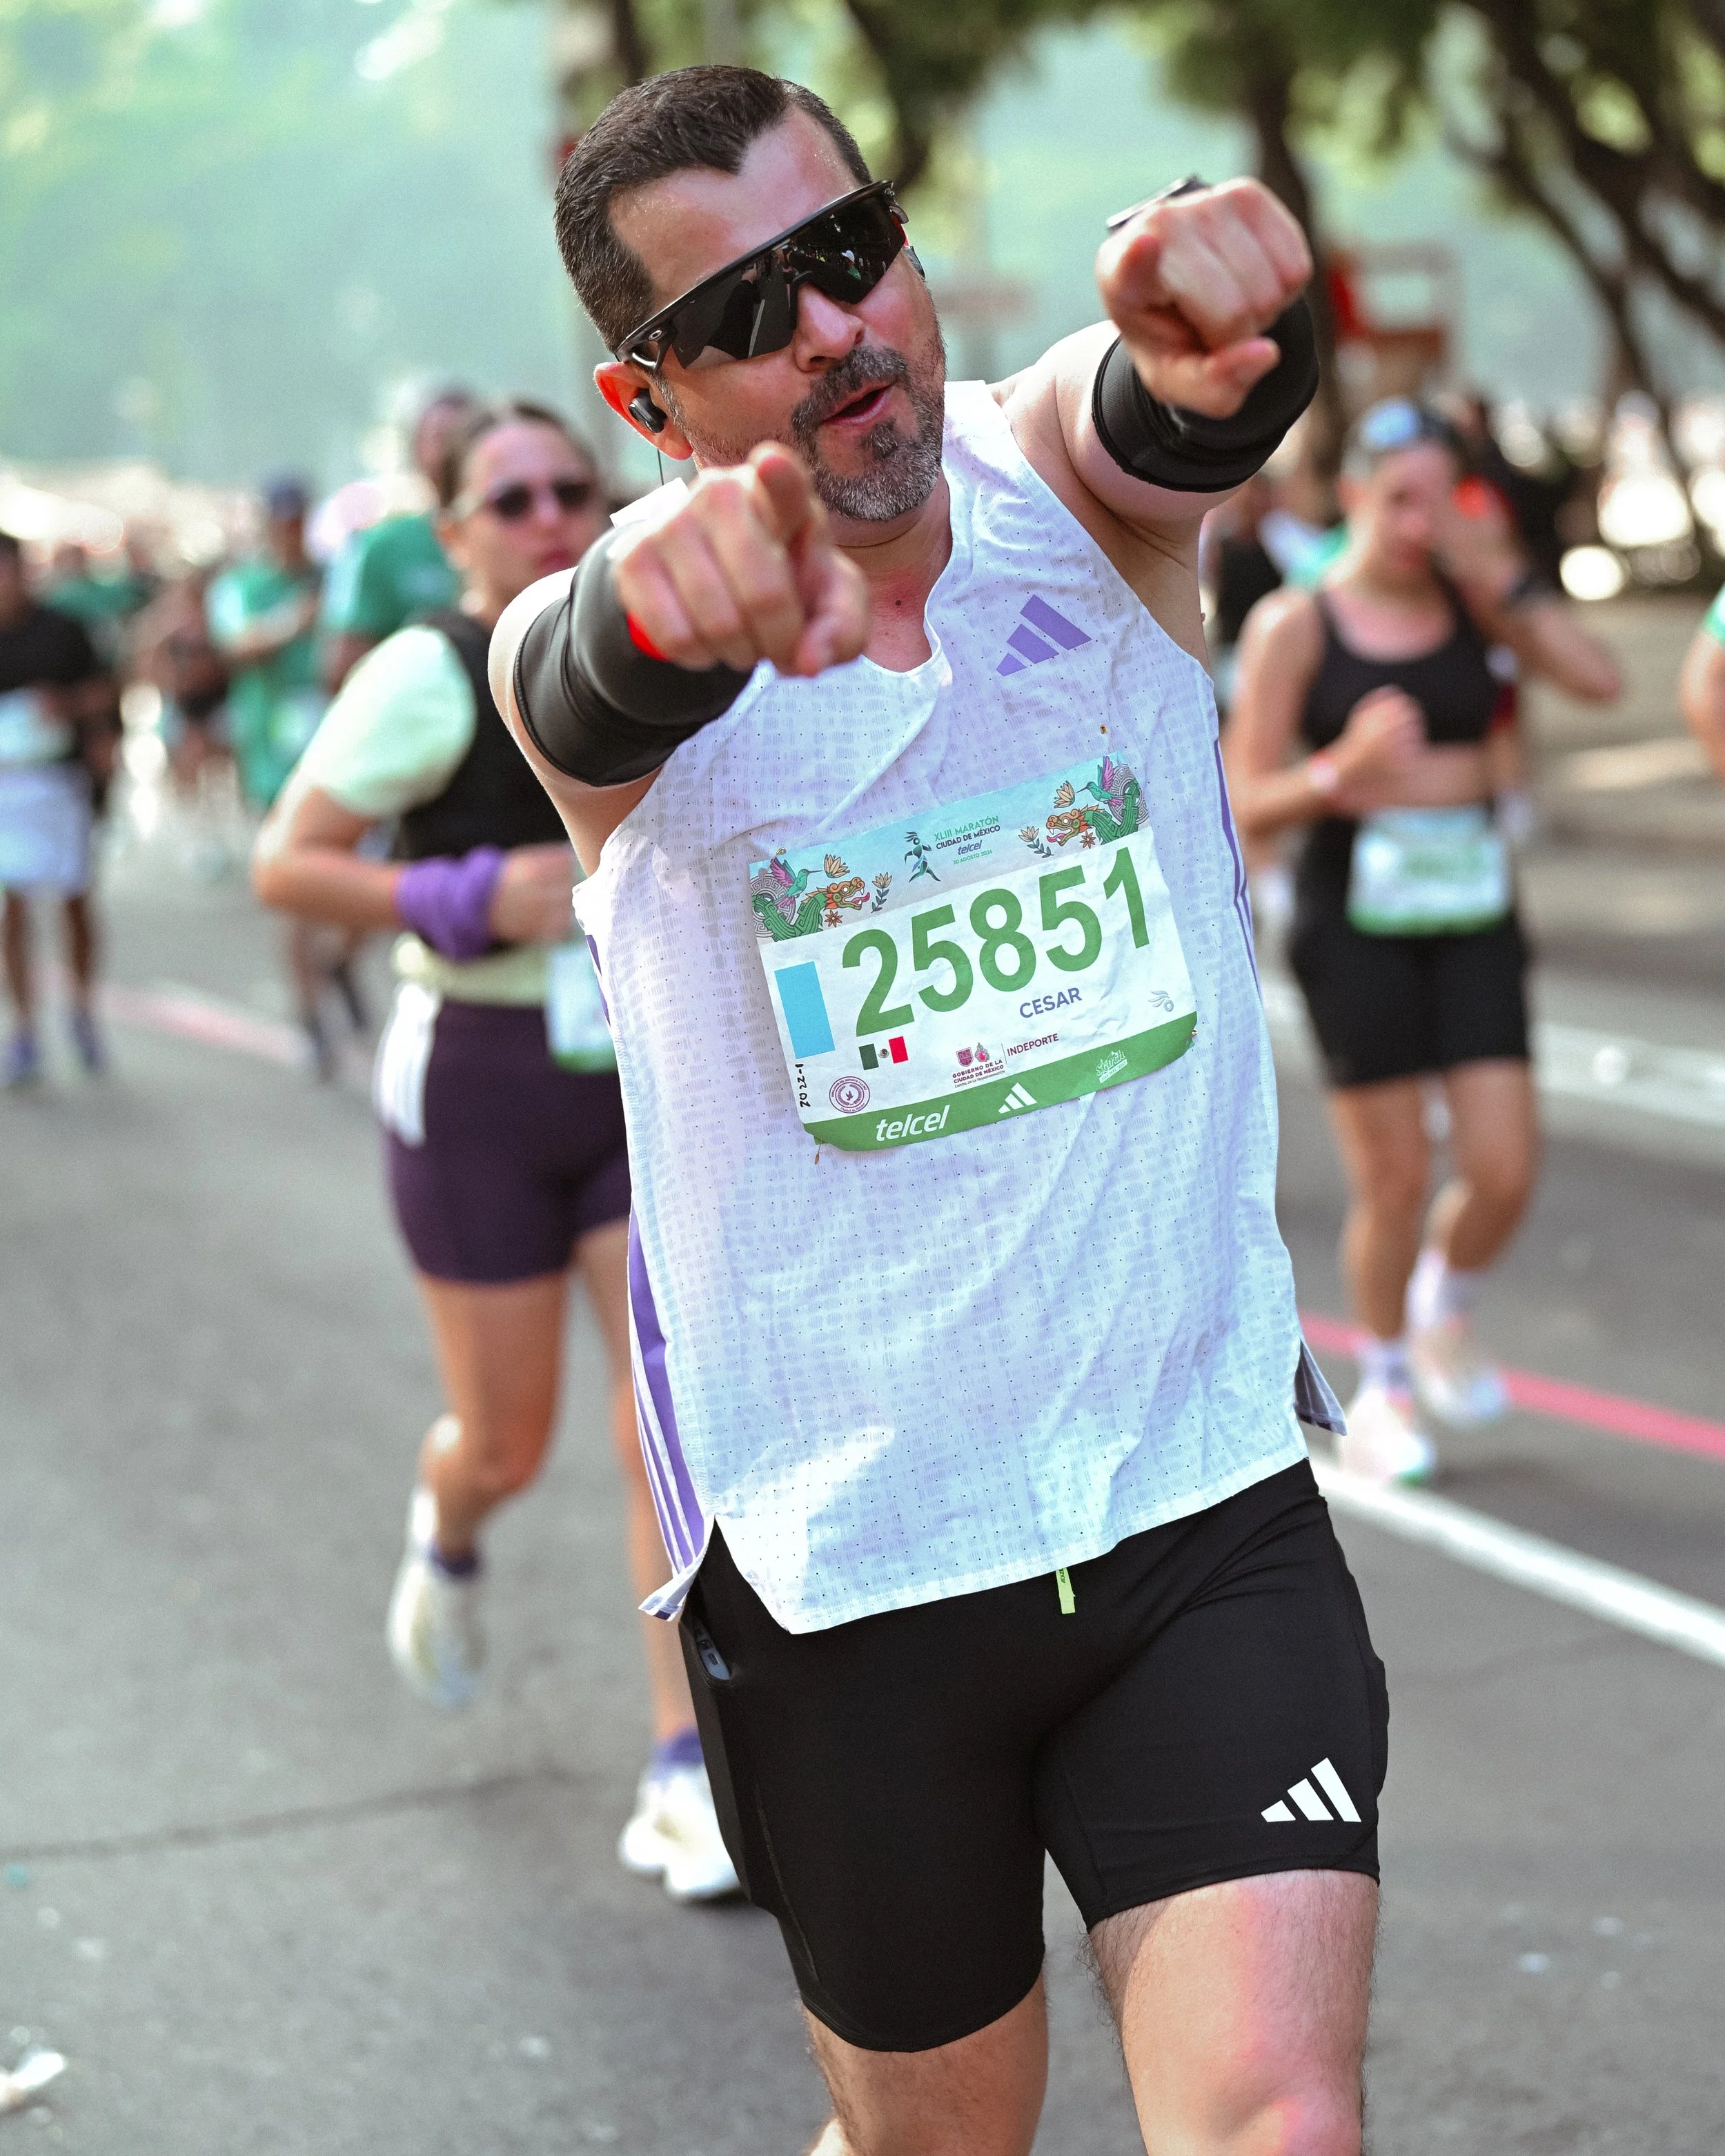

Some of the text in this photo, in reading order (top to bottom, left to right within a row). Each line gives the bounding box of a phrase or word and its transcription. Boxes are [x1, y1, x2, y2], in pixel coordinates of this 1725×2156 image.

[934, 815, 999, 841] XLIII MARATÓN
[936, 824, 1000, 850] CIUDAD DE MÉXICO
[957, 840, 983, 856] telcel
[960, 852, 980, 863] AGOSTO
[842, 847, 1150, 1037] 25851
[1020, 987, 1082, 1018] CESAR
[1007, 1033, 1059, 1056] INDEPORTE
[952, 1065, 983, 1078] GOBIERNO
[954, 1074, 974, 1083] CIUDAD
[983, 1065, 1004, 1074] MÉXICO
[876, 1105, 950, 1142] telcel
